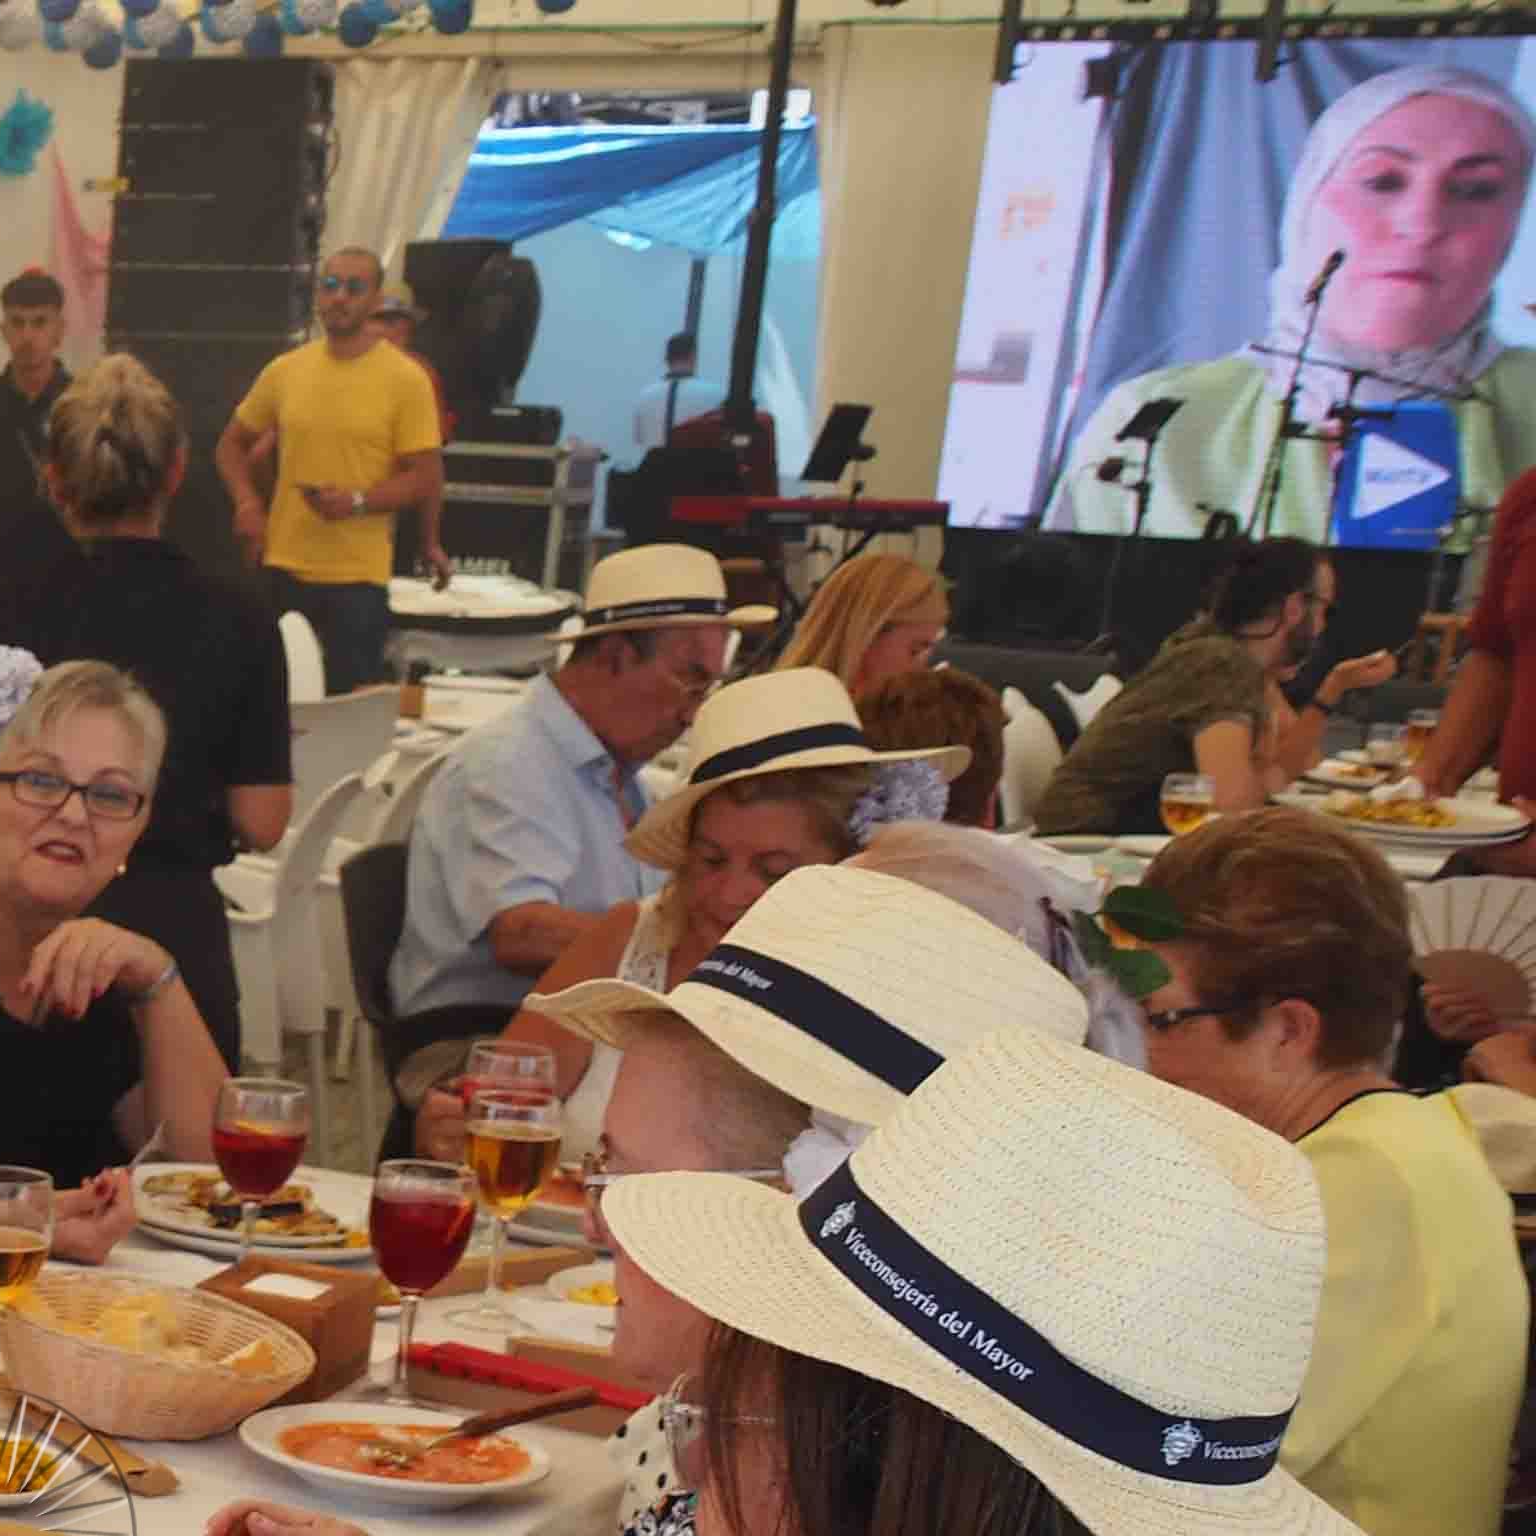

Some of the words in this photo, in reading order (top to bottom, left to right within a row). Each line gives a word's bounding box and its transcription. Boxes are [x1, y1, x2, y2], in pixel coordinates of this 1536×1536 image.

[844, 1226, 939, 1318] Viceconsejería
[938, 1310, 974, 1339] del
[969, 1329, 1035, 1382] Mayor
